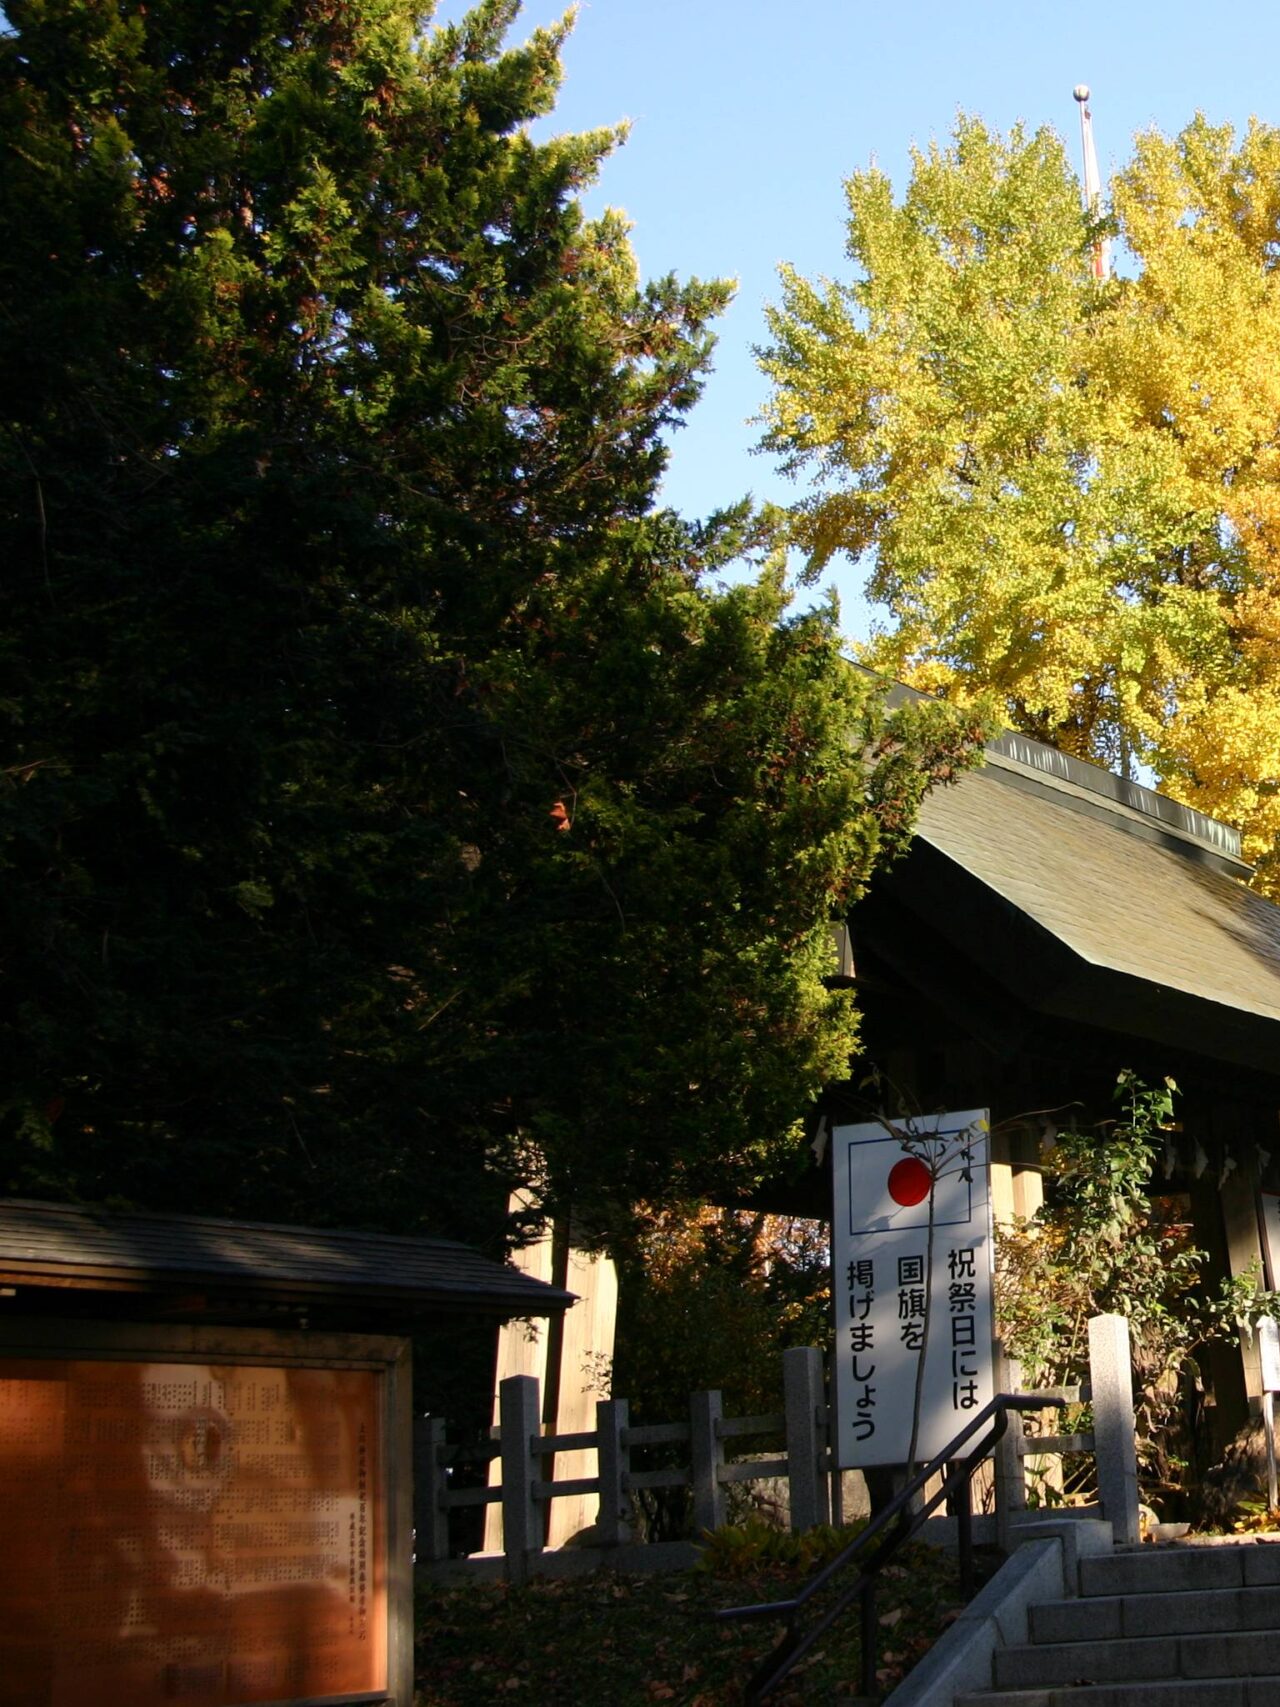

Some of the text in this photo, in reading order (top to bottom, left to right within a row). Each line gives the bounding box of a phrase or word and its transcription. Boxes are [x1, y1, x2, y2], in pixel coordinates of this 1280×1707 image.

[847, 1259, 877, 1442] 掲げましょう
[897, 1254, 927, 1351] 国旗を
[947, 1248, 980, 1411] 祝祭日には
